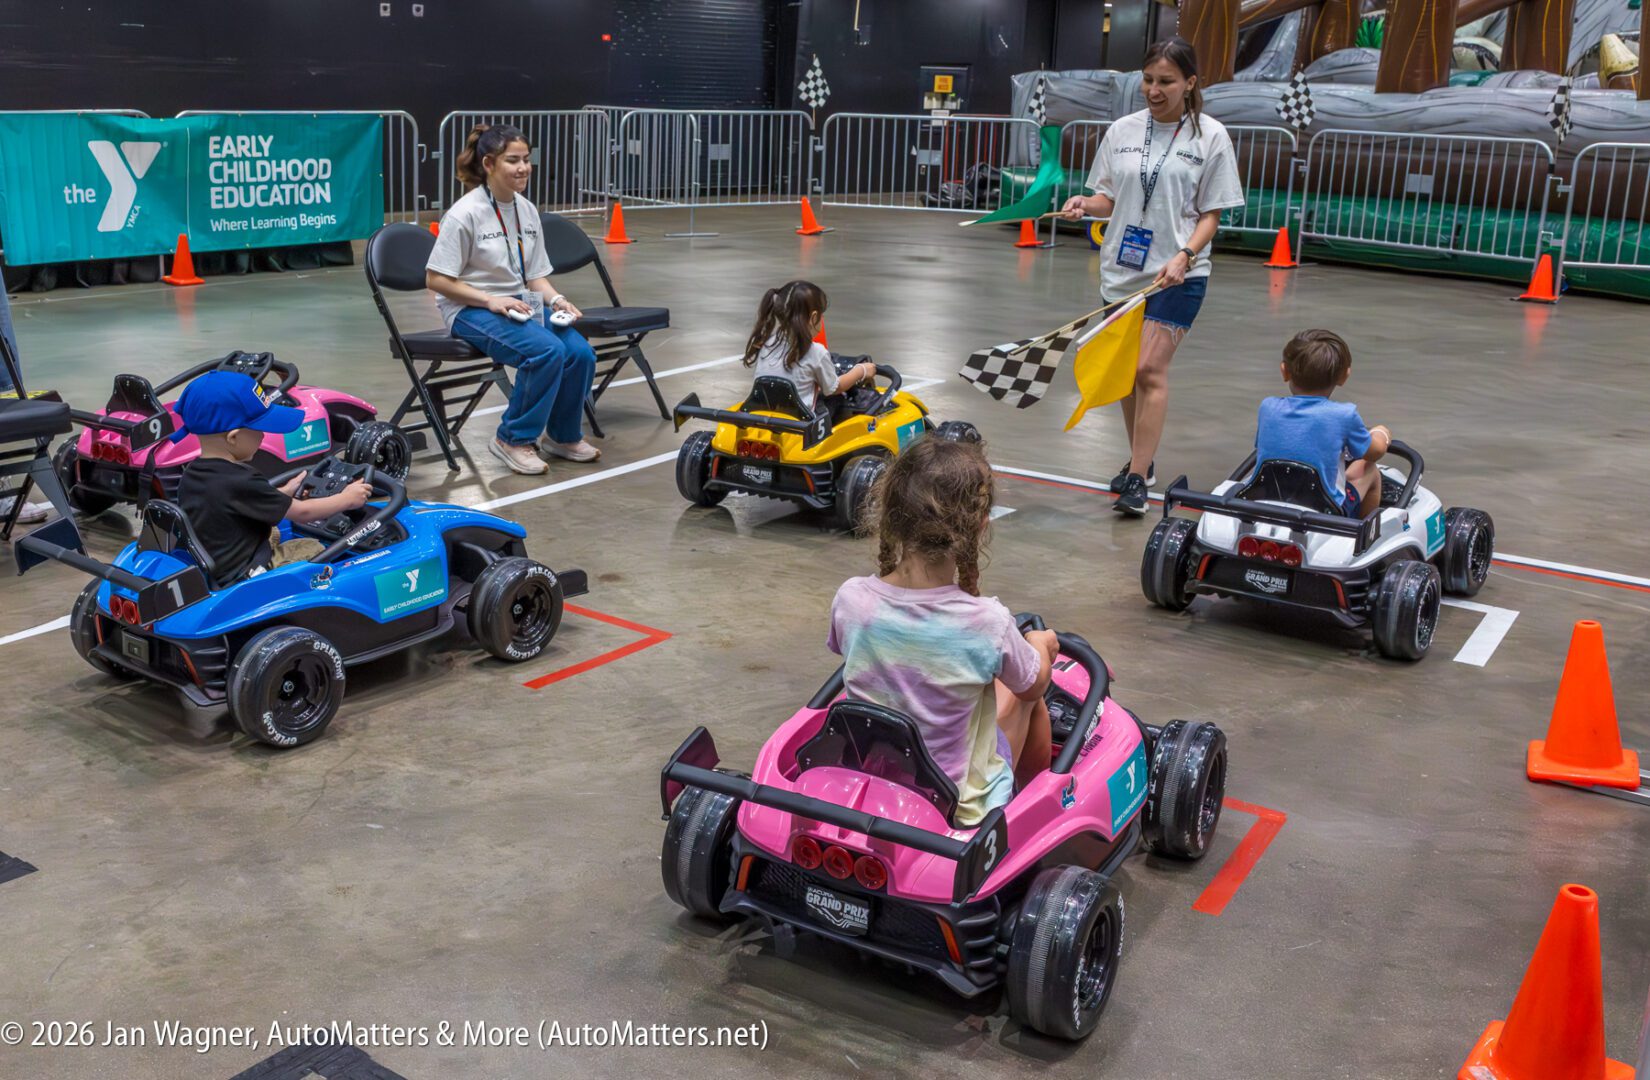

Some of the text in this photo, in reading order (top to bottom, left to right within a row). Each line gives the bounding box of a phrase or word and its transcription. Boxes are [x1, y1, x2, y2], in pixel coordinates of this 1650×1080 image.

[208, 135, 274, 159] EARLY
[208, 158, 332, 184] CHILDHOOD
[63, 184, 96, 204] the
[209, 182, 332, 210] EDUCATION
[126, 204, 142, 229] YMCA
[210, 213, 337, 232] Where Learning Begins
[149, 418, 161, 440] 9
[816, 418, 825, 440] 5
[1369, 517, 1377, 541] 4
[167, 579, 185, 607] 1
[313, 641, 345, 680] GPLB.COM
[984, 830, 997, 871] 3
[806, 892, 869, 920] GRAND PRIX
